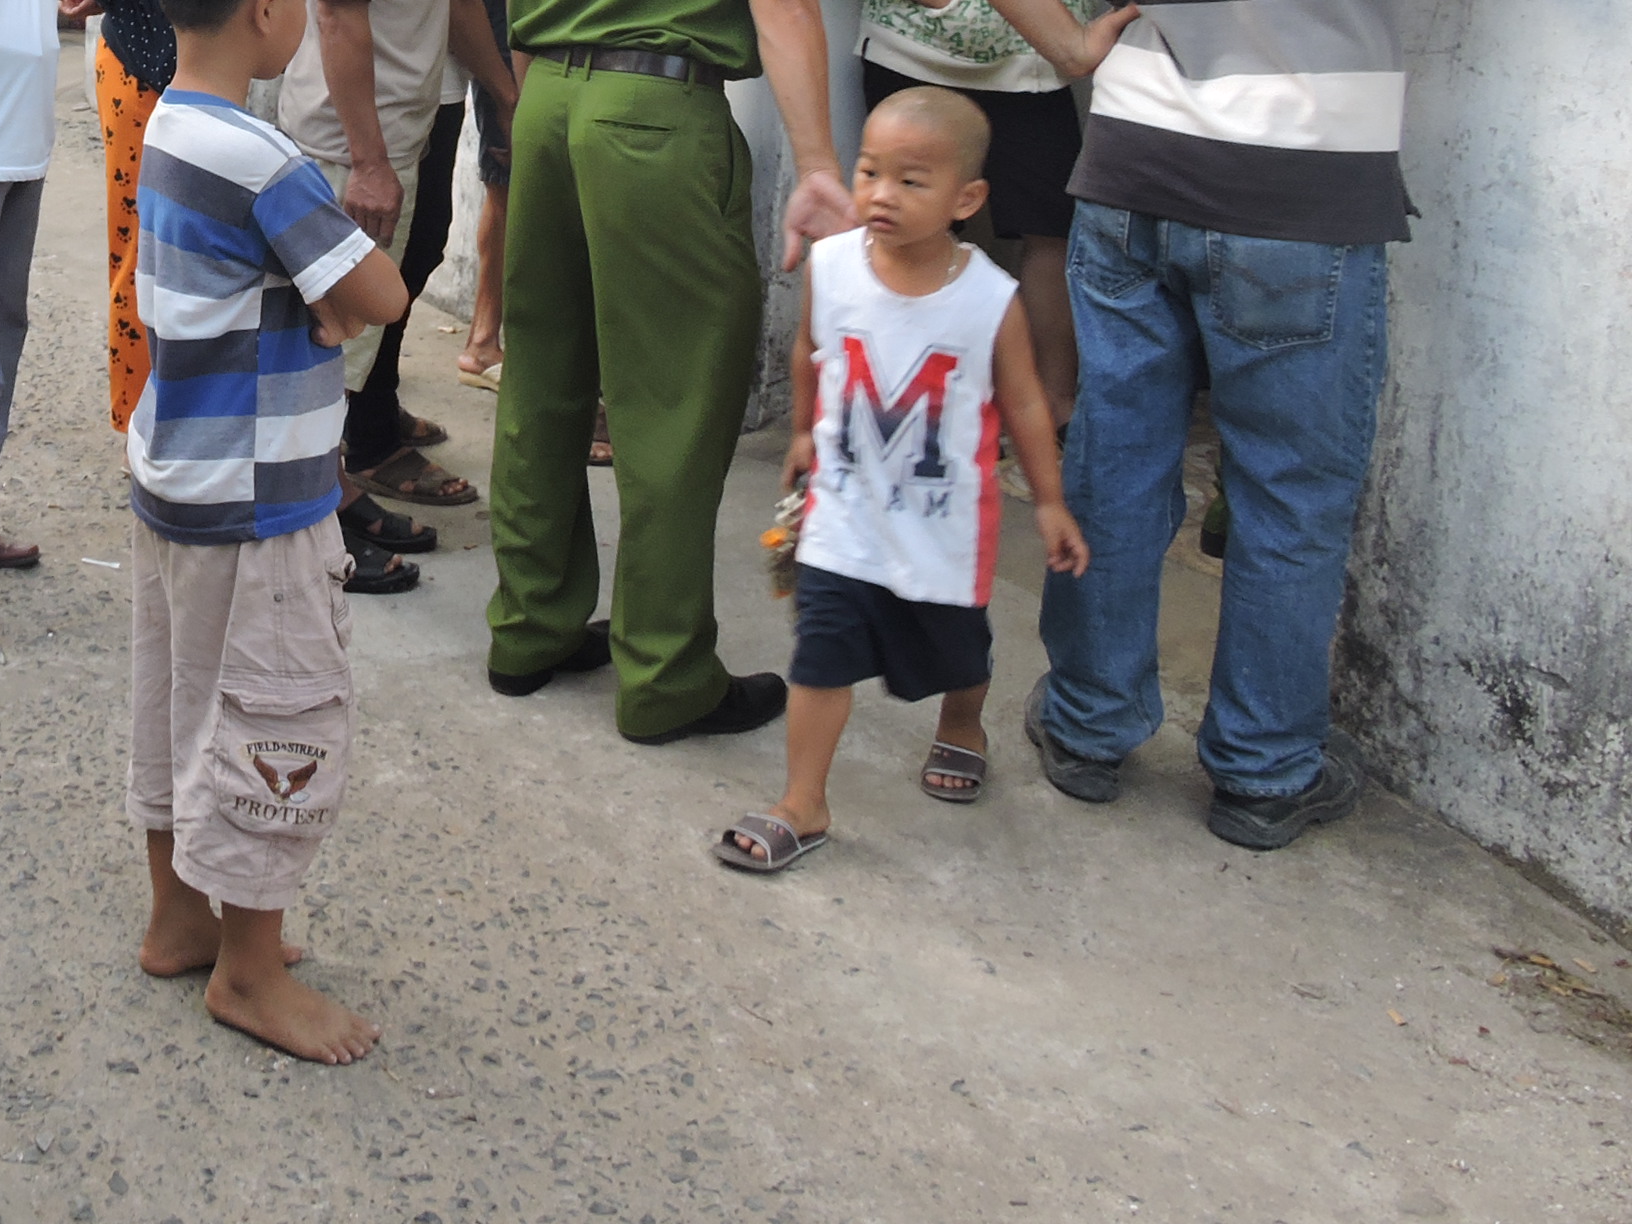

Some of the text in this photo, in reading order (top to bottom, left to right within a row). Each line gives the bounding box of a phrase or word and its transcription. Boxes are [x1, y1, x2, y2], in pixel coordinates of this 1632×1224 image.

[836, 329, 968, 486] M
[246, 741, 281, 756] FIELD
[287, 742, 328, 761] STREAM
[232, 795, 329, 826] PROTEST
